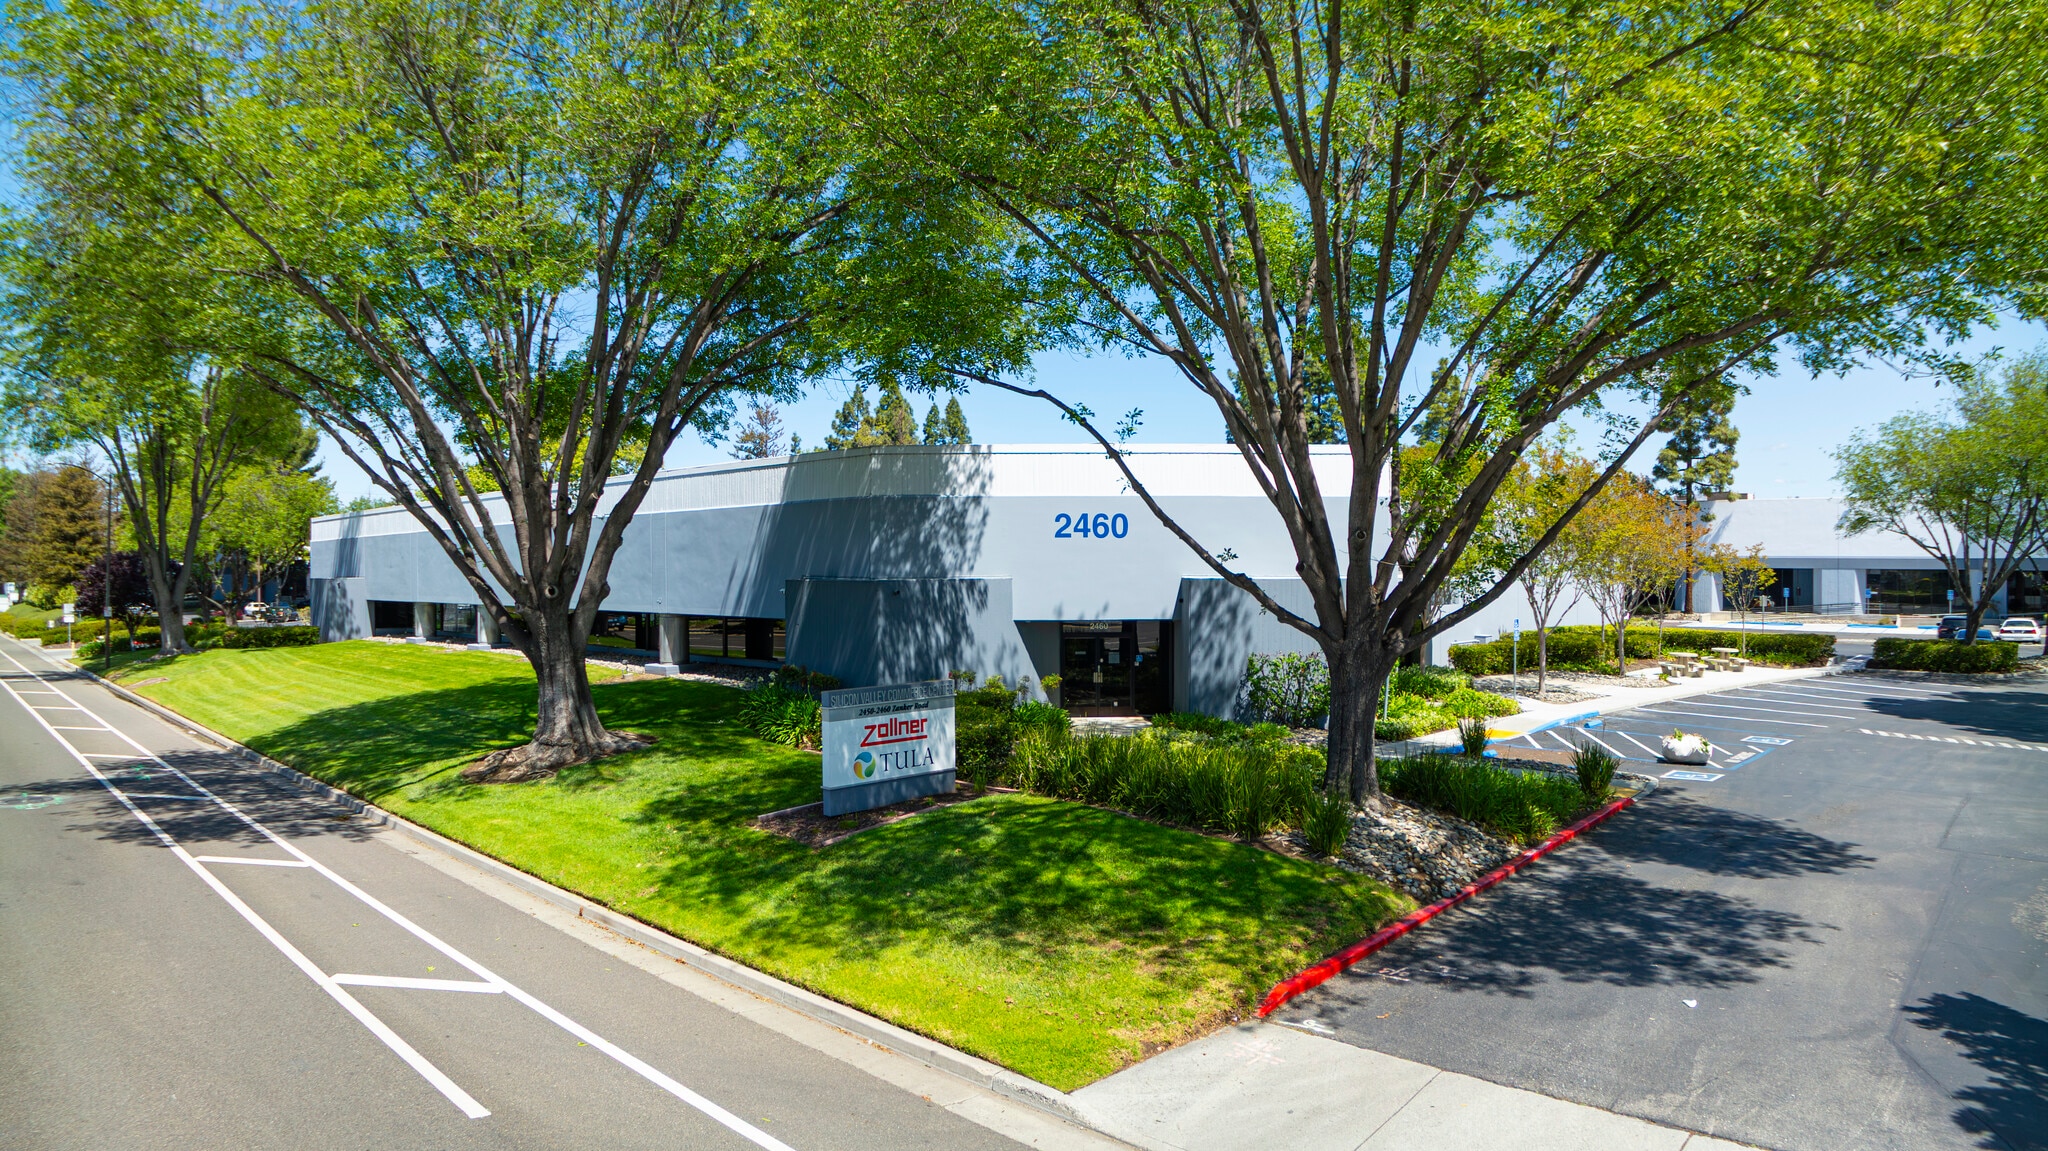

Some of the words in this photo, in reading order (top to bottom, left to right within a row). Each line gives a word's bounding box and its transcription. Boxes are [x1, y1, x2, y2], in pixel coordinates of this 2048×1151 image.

[1054, 513, 1129, 539] 2460
[1089, 622, 1109, 630] 2460
[831, 693, 860, 707] SILICON
[861, 690, 886, 705] VALLEY
[888, 687, 927, 701] COMMERCE
[928, 684, 953, 697] CENTER
[859, 705, 891, 716] 2450-2460
[892, 703, 914, 712] Zanker
[915, 701, 929, 709] Road
[880, 747, 934, 772] TULA
